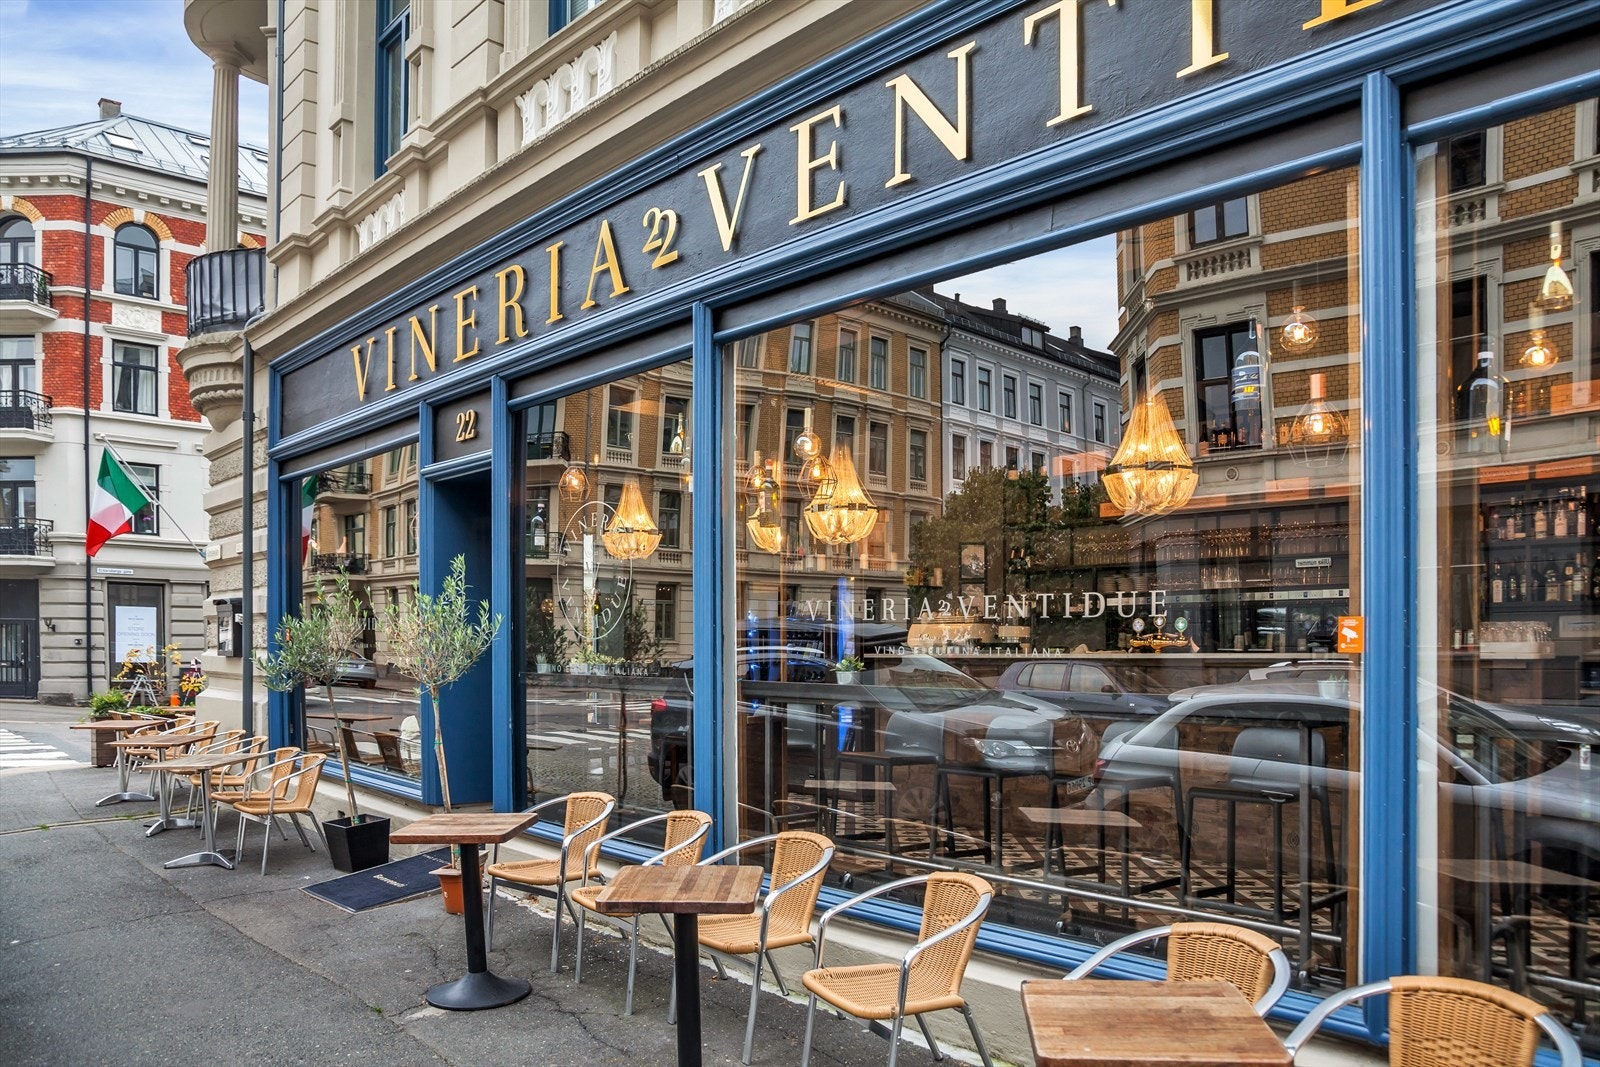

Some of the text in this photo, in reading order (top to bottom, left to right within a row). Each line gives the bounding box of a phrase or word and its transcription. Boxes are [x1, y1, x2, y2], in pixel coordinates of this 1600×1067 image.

[351, 0, 1384, 402] VINERIA 22 VENTI
[455, 409, 478, 442] 22
[806, 597, 935, 622] VINERIA
[957, 590, 1168, 620] VENTIDUE
[875, 646, 905, 655] VINO
[990, 648, 1062, 658] ITALIANA
